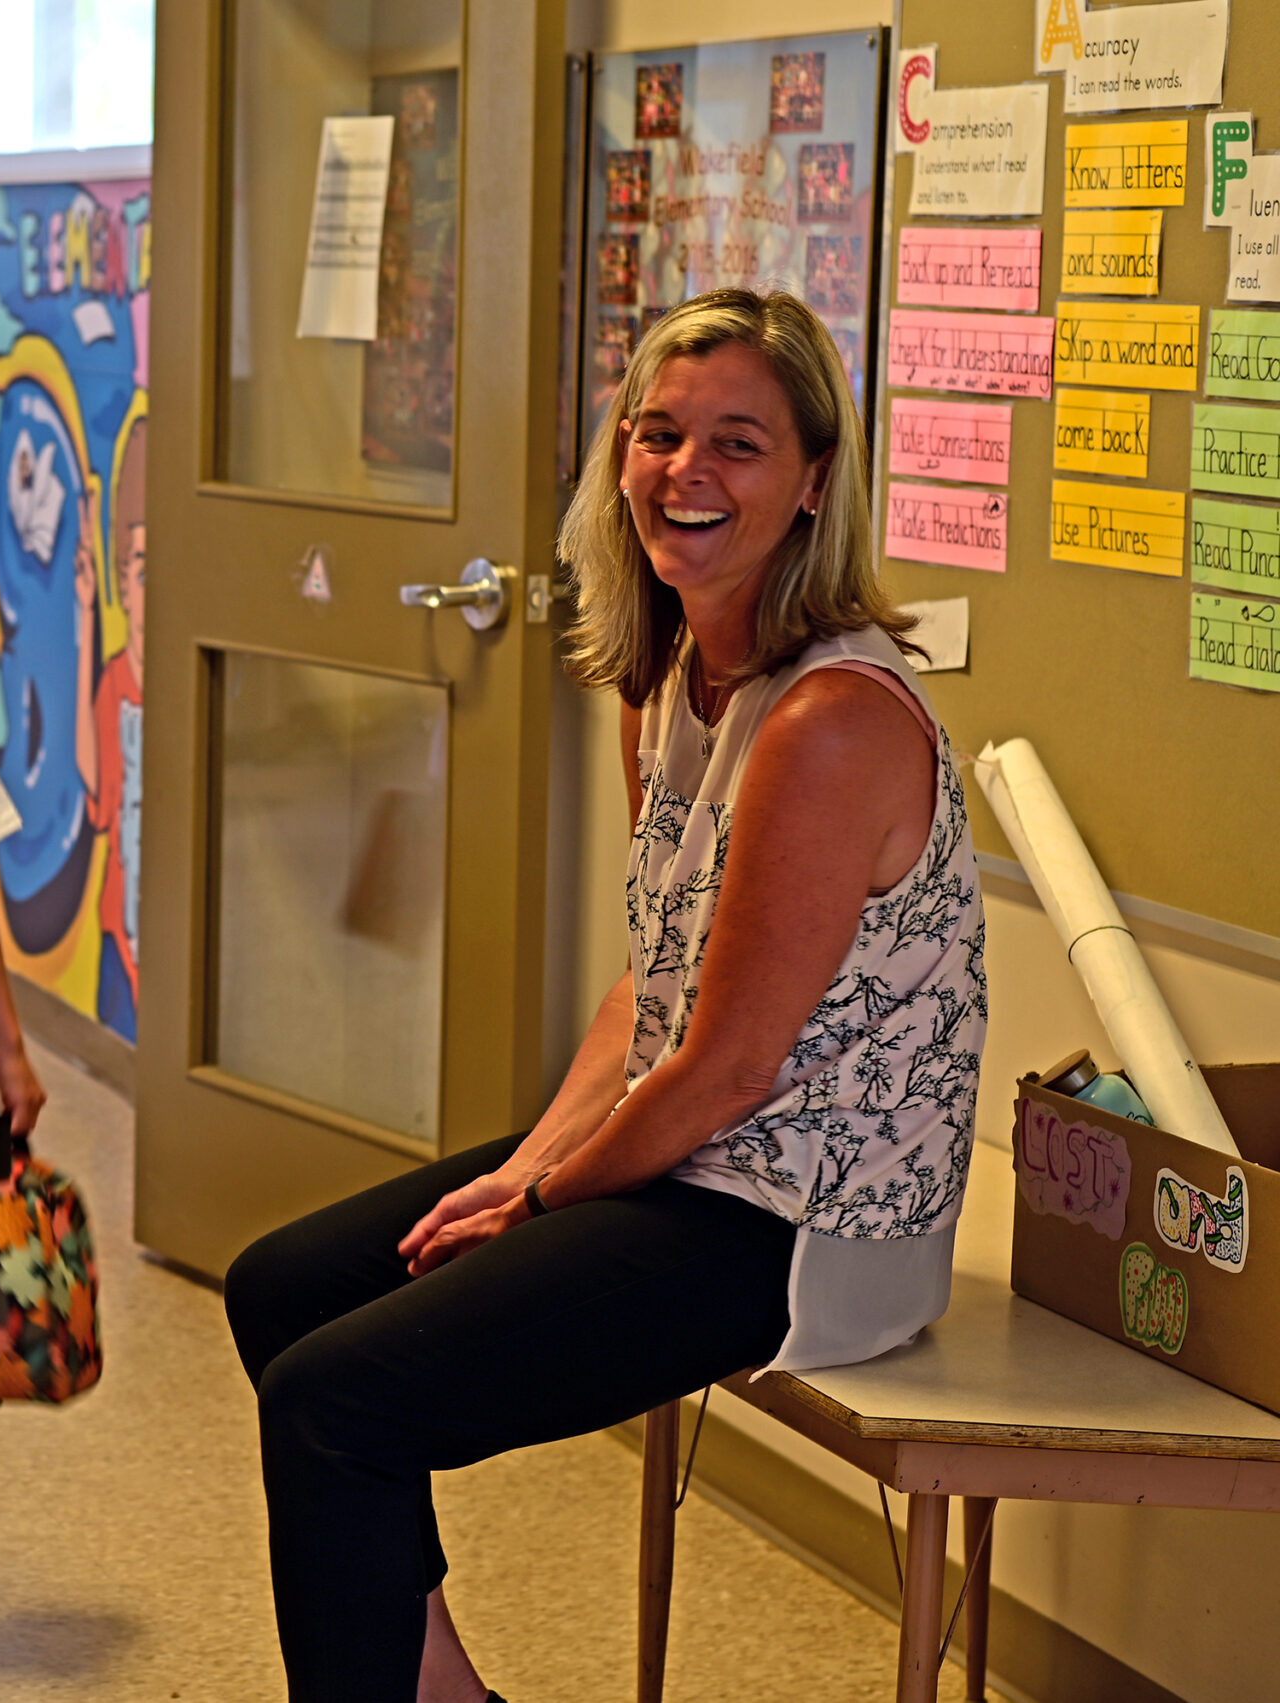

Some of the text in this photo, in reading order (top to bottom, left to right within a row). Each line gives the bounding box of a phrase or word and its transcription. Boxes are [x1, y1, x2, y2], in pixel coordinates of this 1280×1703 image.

[1072, 68, 1183, 96] I can read the words.
[925, 155, 969, 174] understand
[972, 154, 995, 173] what
[1005, 154, 1028, 173] read
[1070, 145, 1183, 191] Know letters
[1067, 234, 1154, 278] and sounds
[1237, 233, 1280, 255] I use all
[935, 262, 948, 301] up
[952, 247, 974, 287] and
[1235, 269, 1261, 289] read.
[931, 328, 946, 368] for
[951, 329, 1050, 394] Understanding
[1101, 340, 1111, 362] a
[1117, 322, 1157, 365] word
[1162, 324, 1194, 368] and
[1211, 332, 1251, 380] Read
[929, 416, 1005, 463] Connections
[1056, 425, 1094, 451] come
[1203, 427, 1268, 478] Practice
[933, 502, 1001, 549] Predictions
[1052, 503, 1149, 556] Use Pictures
[1194, 521, 1232, 571] Read
[1199, 617, 1235, 666] Read
[1022, 1097, 1115, 1202] LOST
